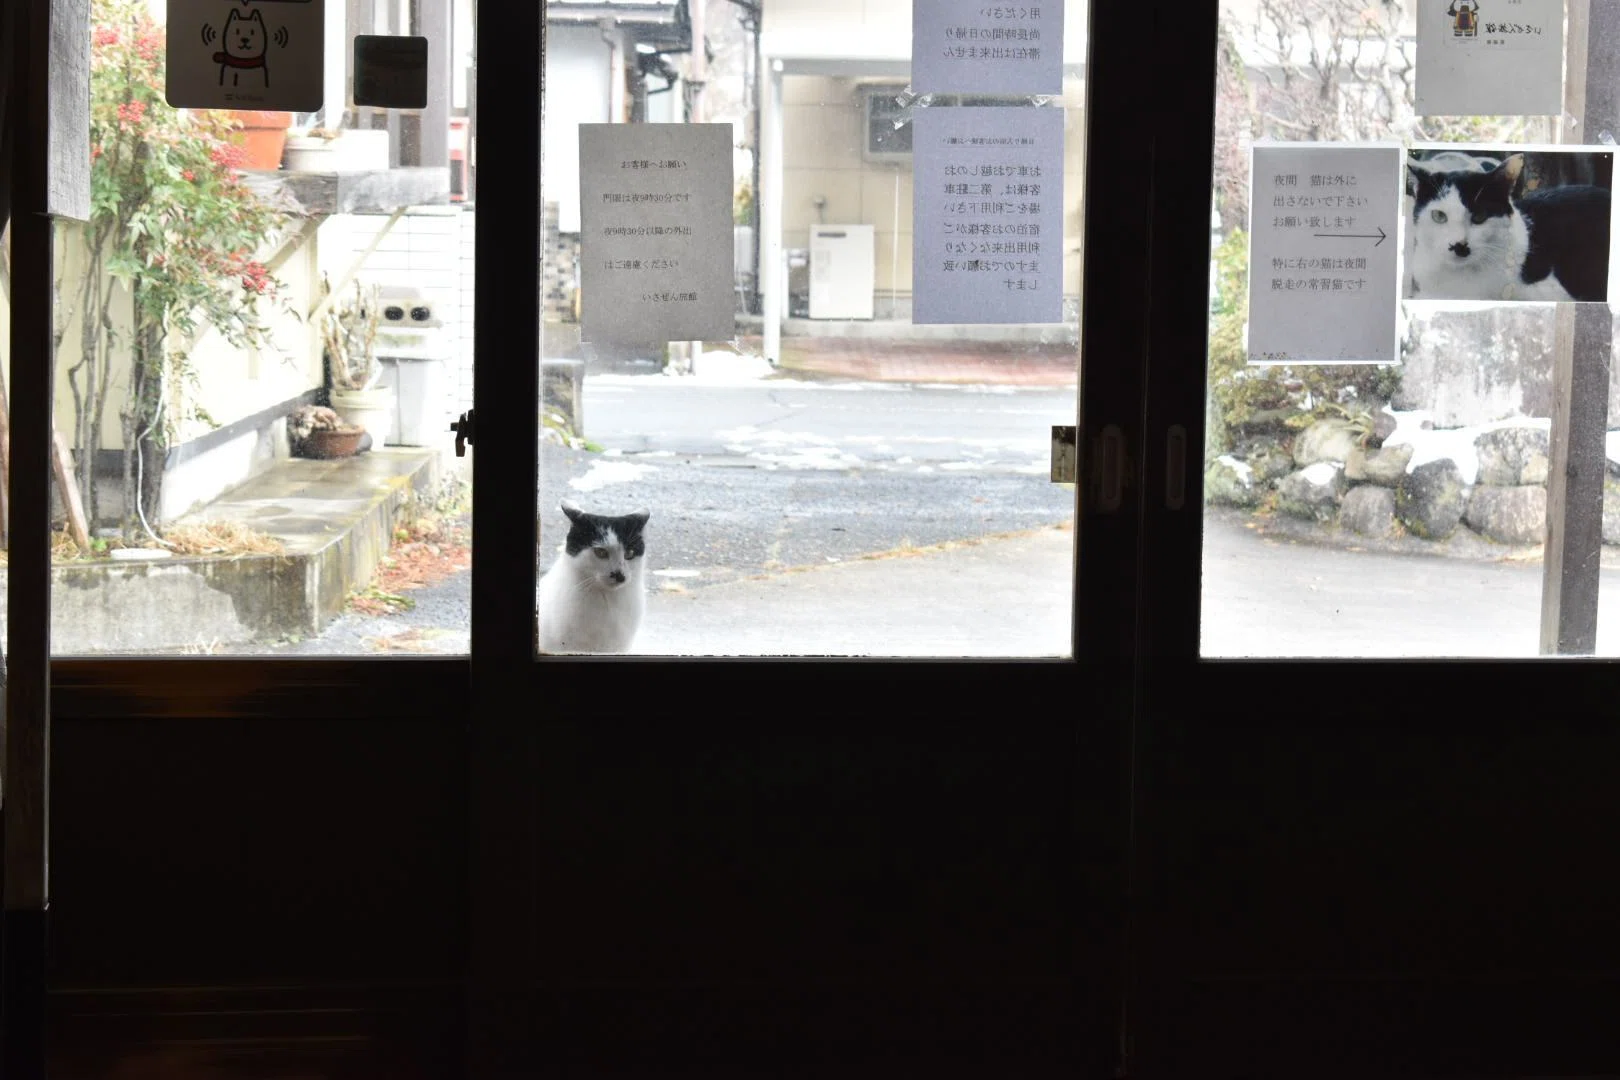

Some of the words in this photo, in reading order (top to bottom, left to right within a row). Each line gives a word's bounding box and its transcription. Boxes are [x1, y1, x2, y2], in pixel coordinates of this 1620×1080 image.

[620, 159, 688, 170] お客様へお願い
[1273, 174, 1297, 186] 夜間
[1309, 174, 1358, 188] 猫は外に
[1273, 195, 1369, 207] 出さないで下さい
[1272, 215, 1357, 228] お願い致します
[604, 259, 680, 270] はご遠慮ください
[1271, 256, 1367, 270] 特に右の猫は夜間
[1271, 277, 1367, 290] 脱走の常習猫です
